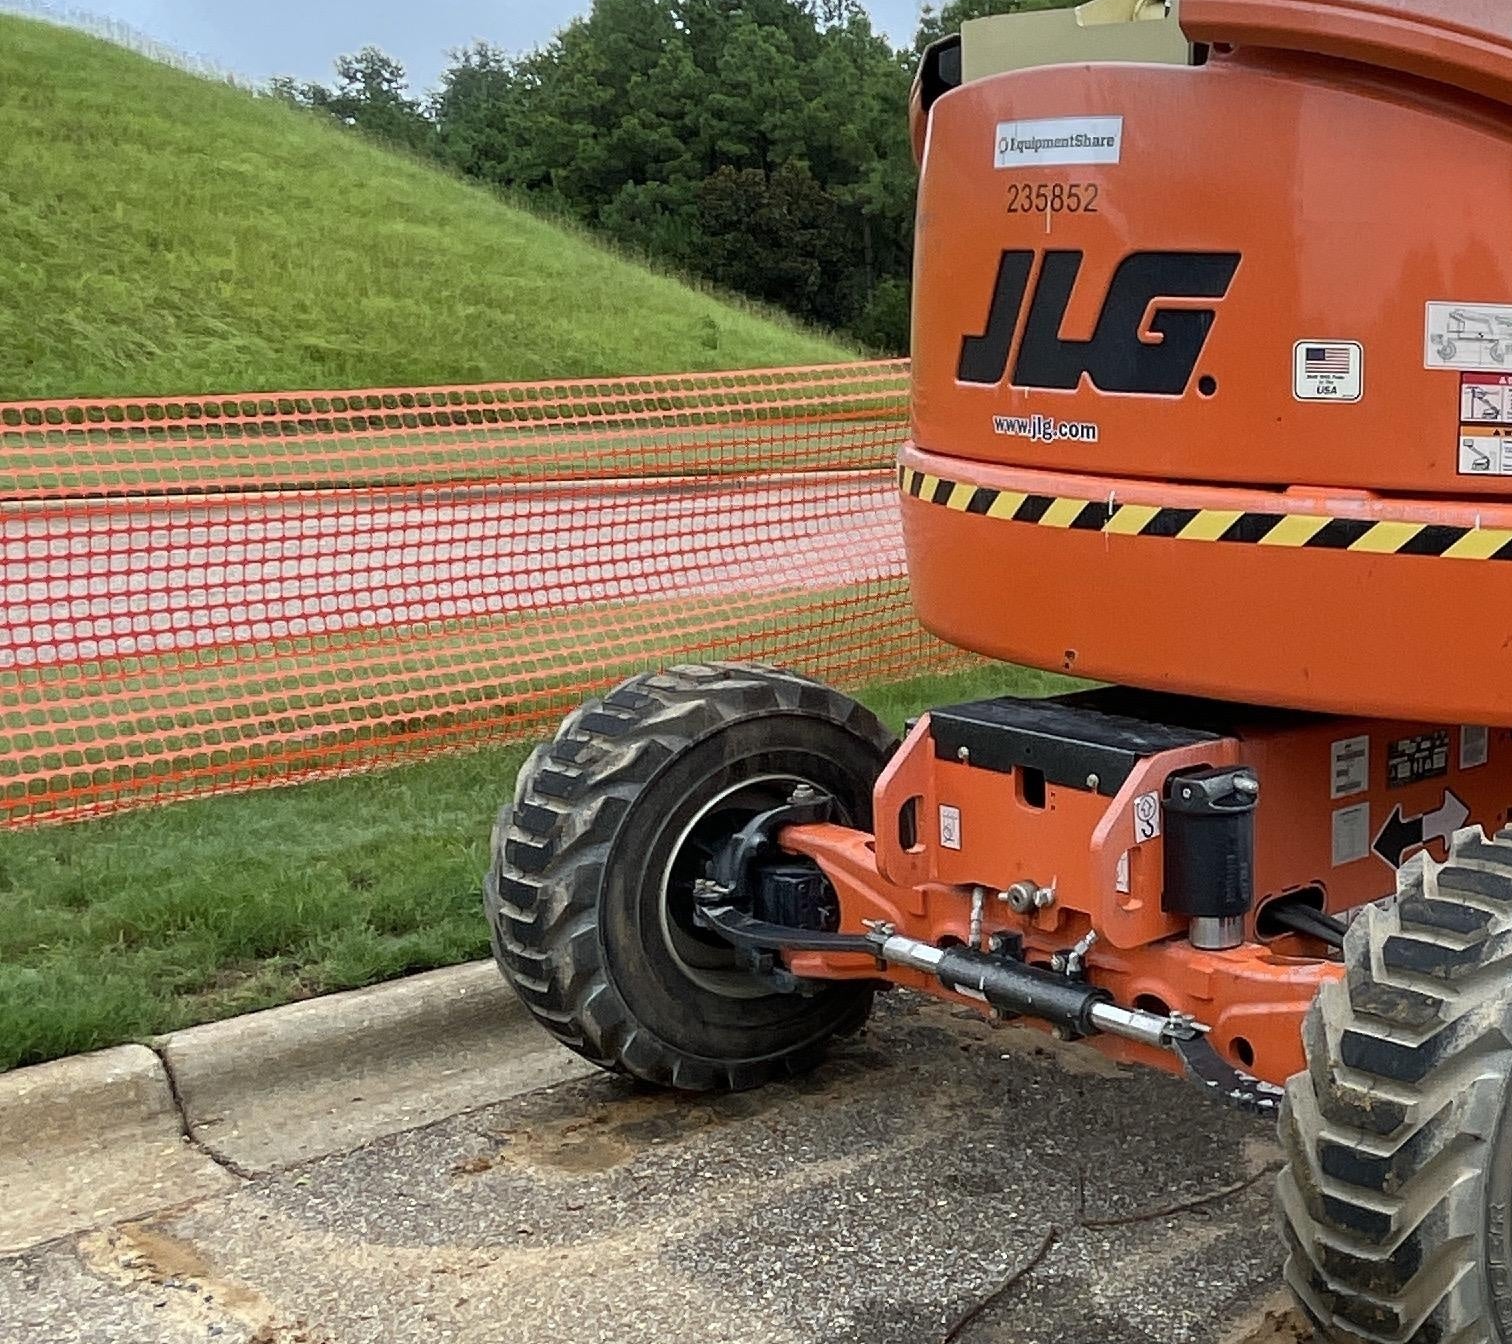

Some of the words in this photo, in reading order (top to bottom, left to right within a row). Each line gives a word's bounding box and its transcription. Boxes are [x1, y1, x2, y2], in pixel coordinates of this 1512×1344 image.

[1007, 183, 1099, 213] 235852
[1316, 385, 1338, 395] USA
[994, 416, 1097, 441] www.jlg.com
